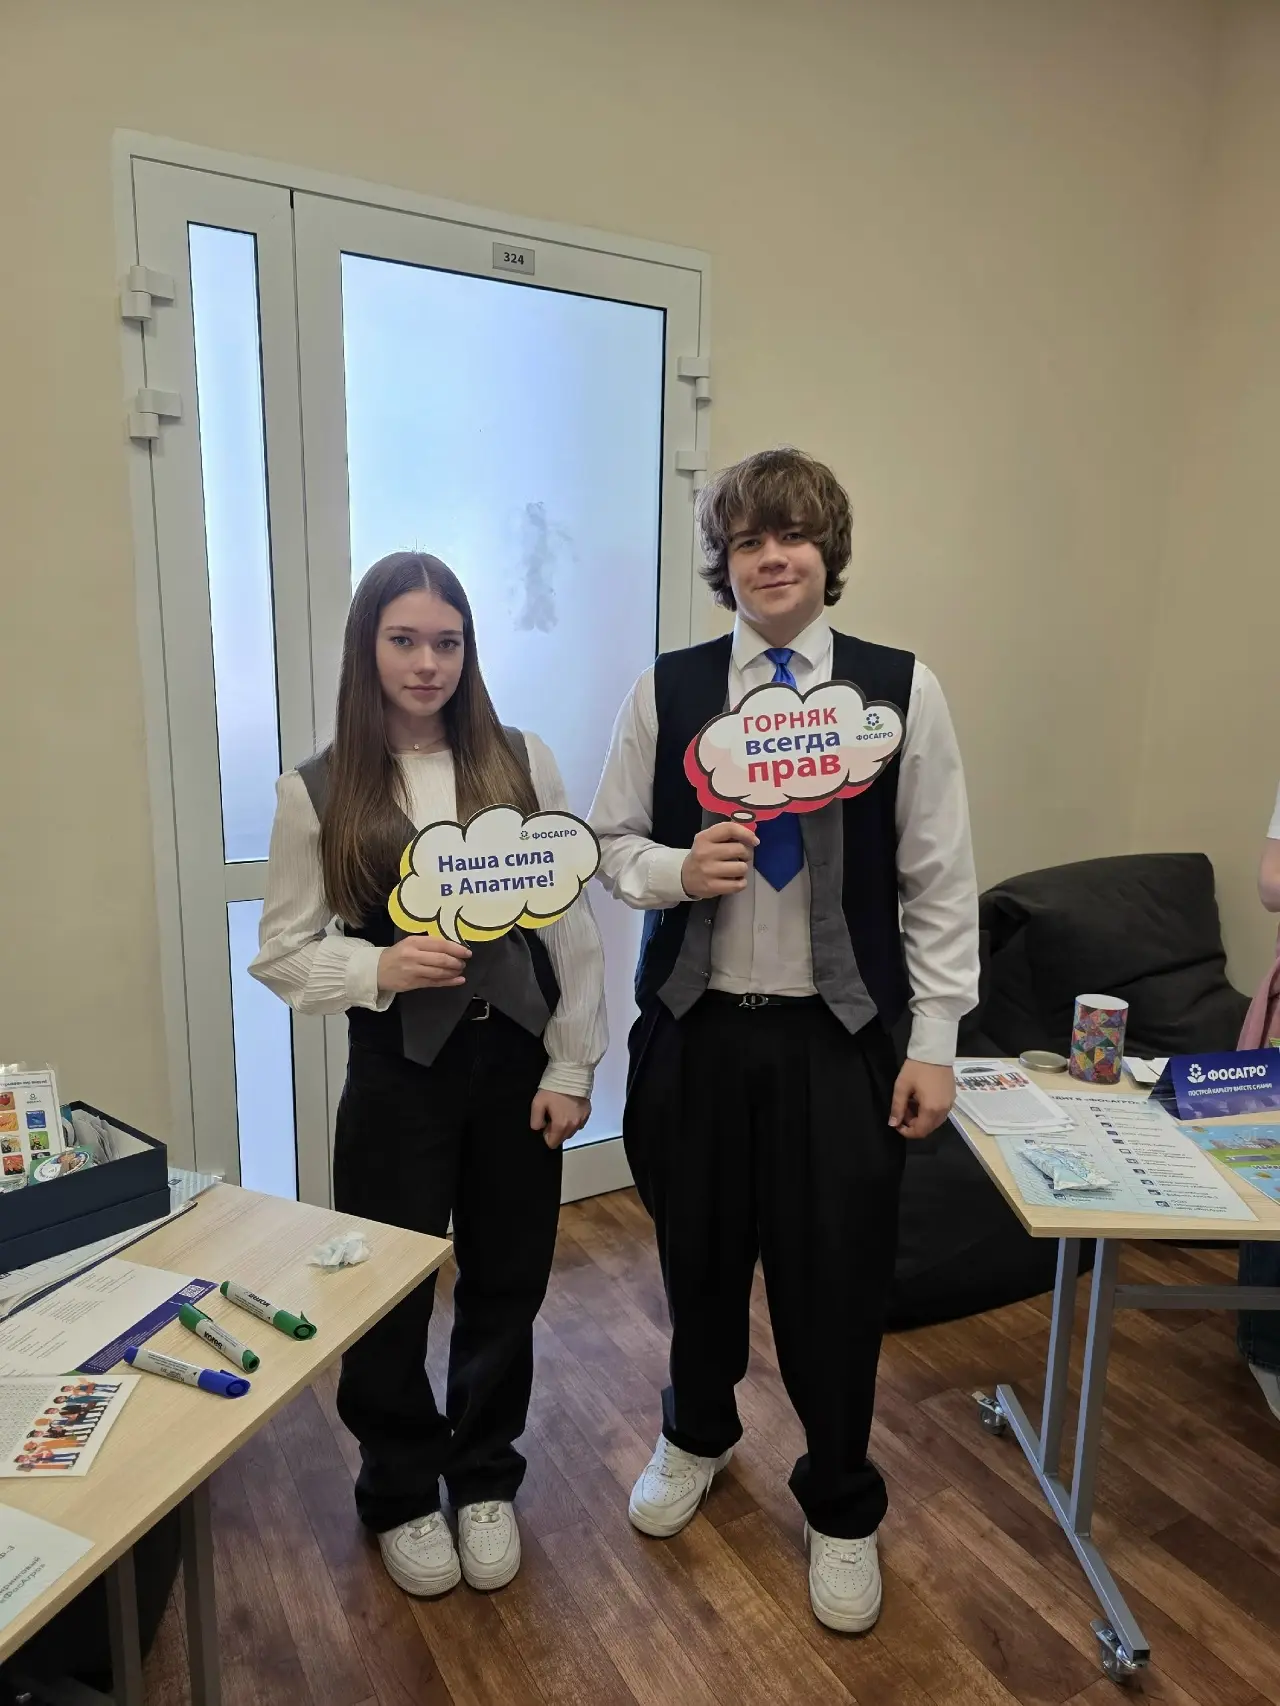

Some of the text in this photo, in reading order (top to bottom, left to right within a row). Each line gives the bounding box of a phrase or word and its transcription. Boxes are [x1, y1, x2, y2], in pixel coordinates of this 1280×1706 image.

[503, 251, 525, 265] 324
[743, 707, 838, 734] ГОРНЯК
[745, 731, 841, 756] всегда
[855, 731, 894, 741] ФОСАГРО
[747, 754, 842, 788] прав
[531, 829, 578, 840] ФОСАГРО
[438, 850, 555, 873] Наша сила
[440, 869, 555, 897] в Апатите!
[1187, 1087, 1212, 1097] ПОСТРОЙ
